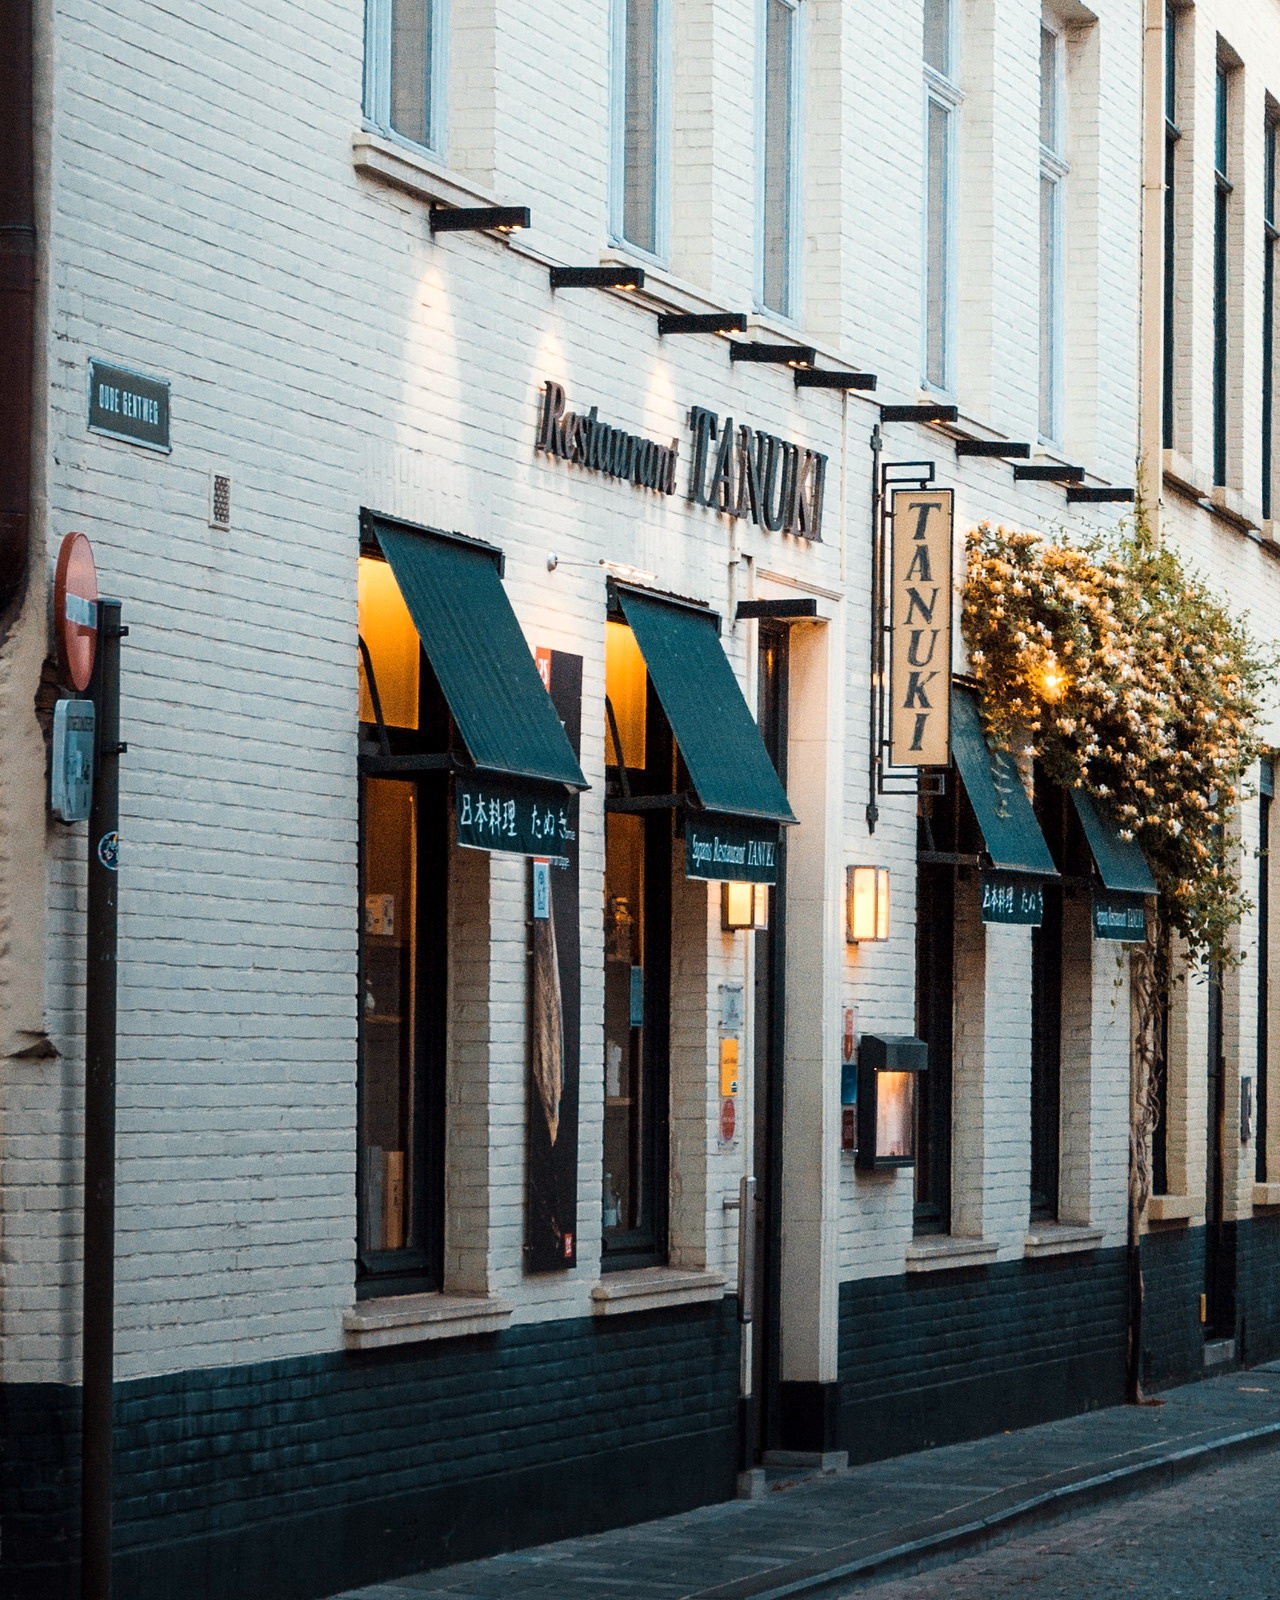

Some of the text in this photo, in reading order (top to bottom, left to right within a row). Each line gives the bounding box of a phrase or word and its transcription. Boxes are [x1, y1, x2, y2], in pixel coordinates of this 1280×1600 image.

[99, 383, 159, 425] OUDE GENTWEG
[536, 380, 829, 543] Restaurant TANUKI
[902, 502, 943, 751] TANUKI
[461, 793, 518, 837] 日本料理
